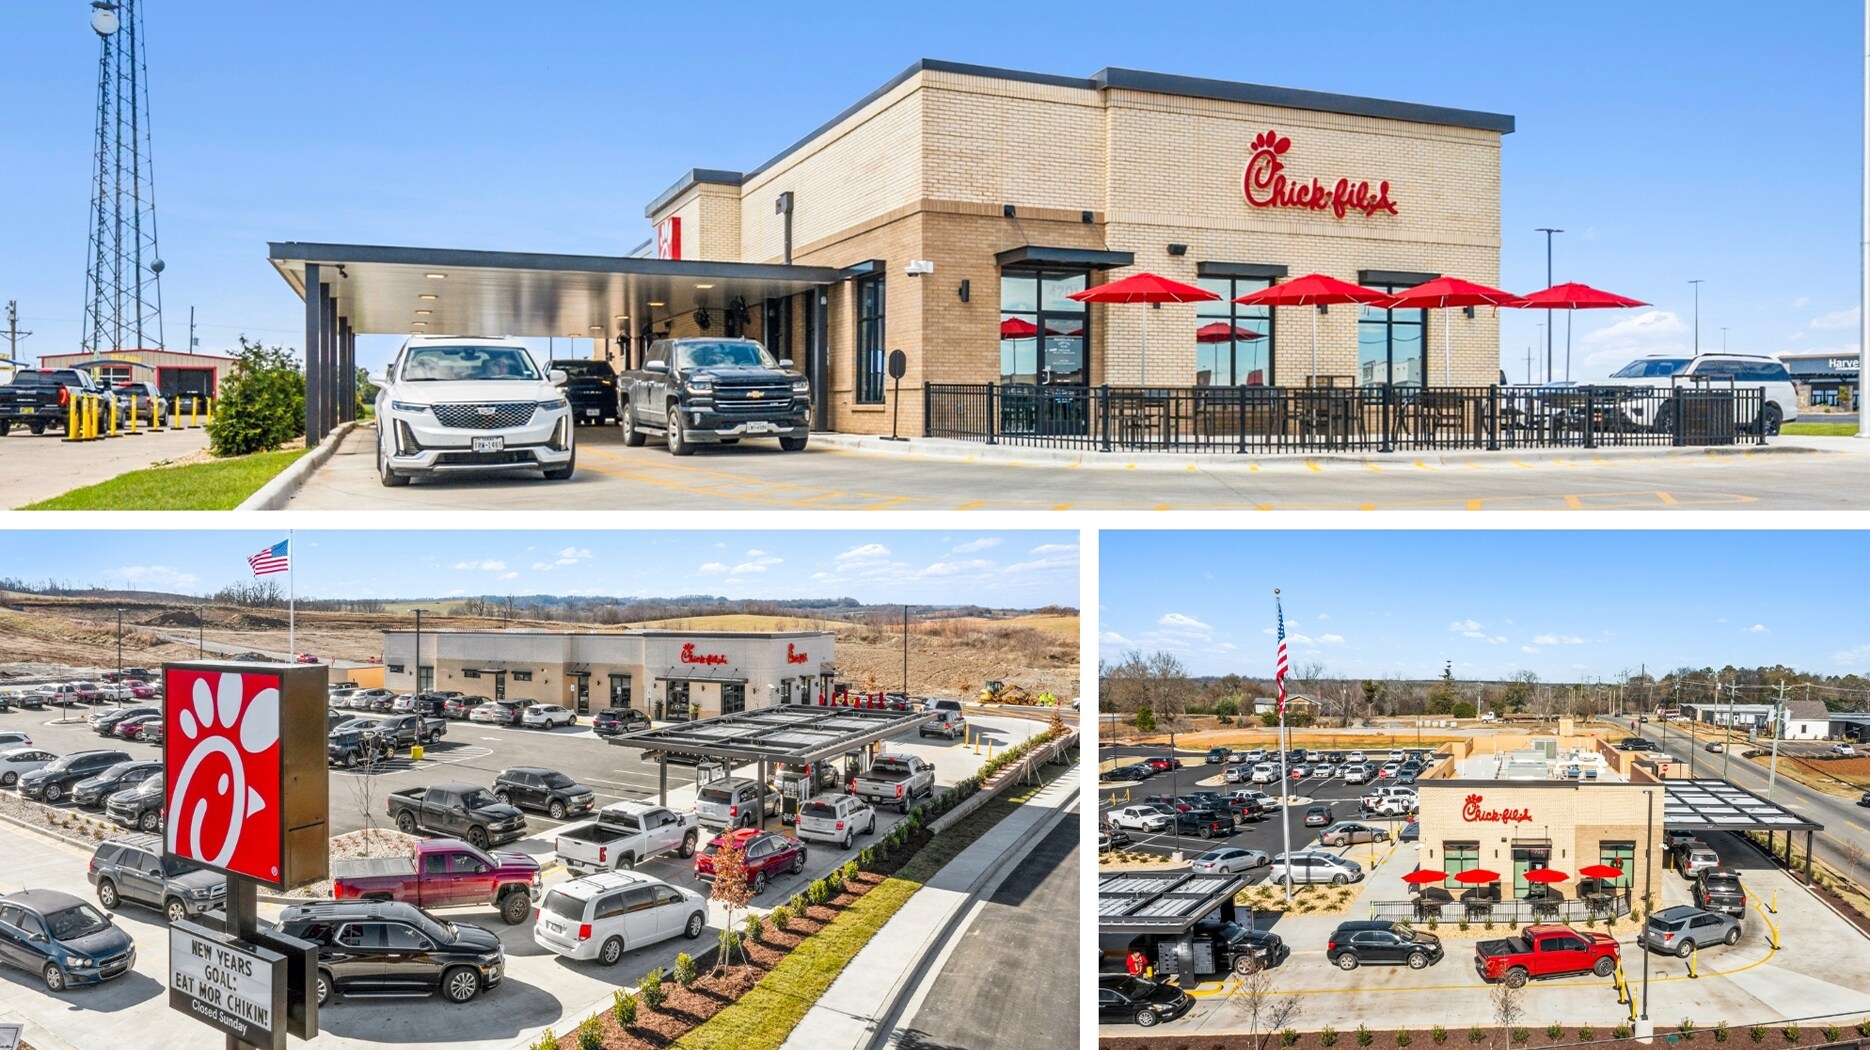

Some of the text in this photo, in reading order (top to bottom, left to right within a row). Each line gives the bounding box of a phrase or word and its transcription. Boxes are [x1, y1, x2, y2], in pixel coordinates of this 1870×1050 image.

[1244, 130, 1399, 219] Chick-fil-A
[1462, 793, 1533, 824] Chick-fil-A
[191, 939, 252, 977] NEW YEARS
[205, 965, 237, 991] GOAL:
[176, 972, 268, 1027] EAT MOR CHIKIN!
[192, 999, 248, 1036] Closed Sunday
